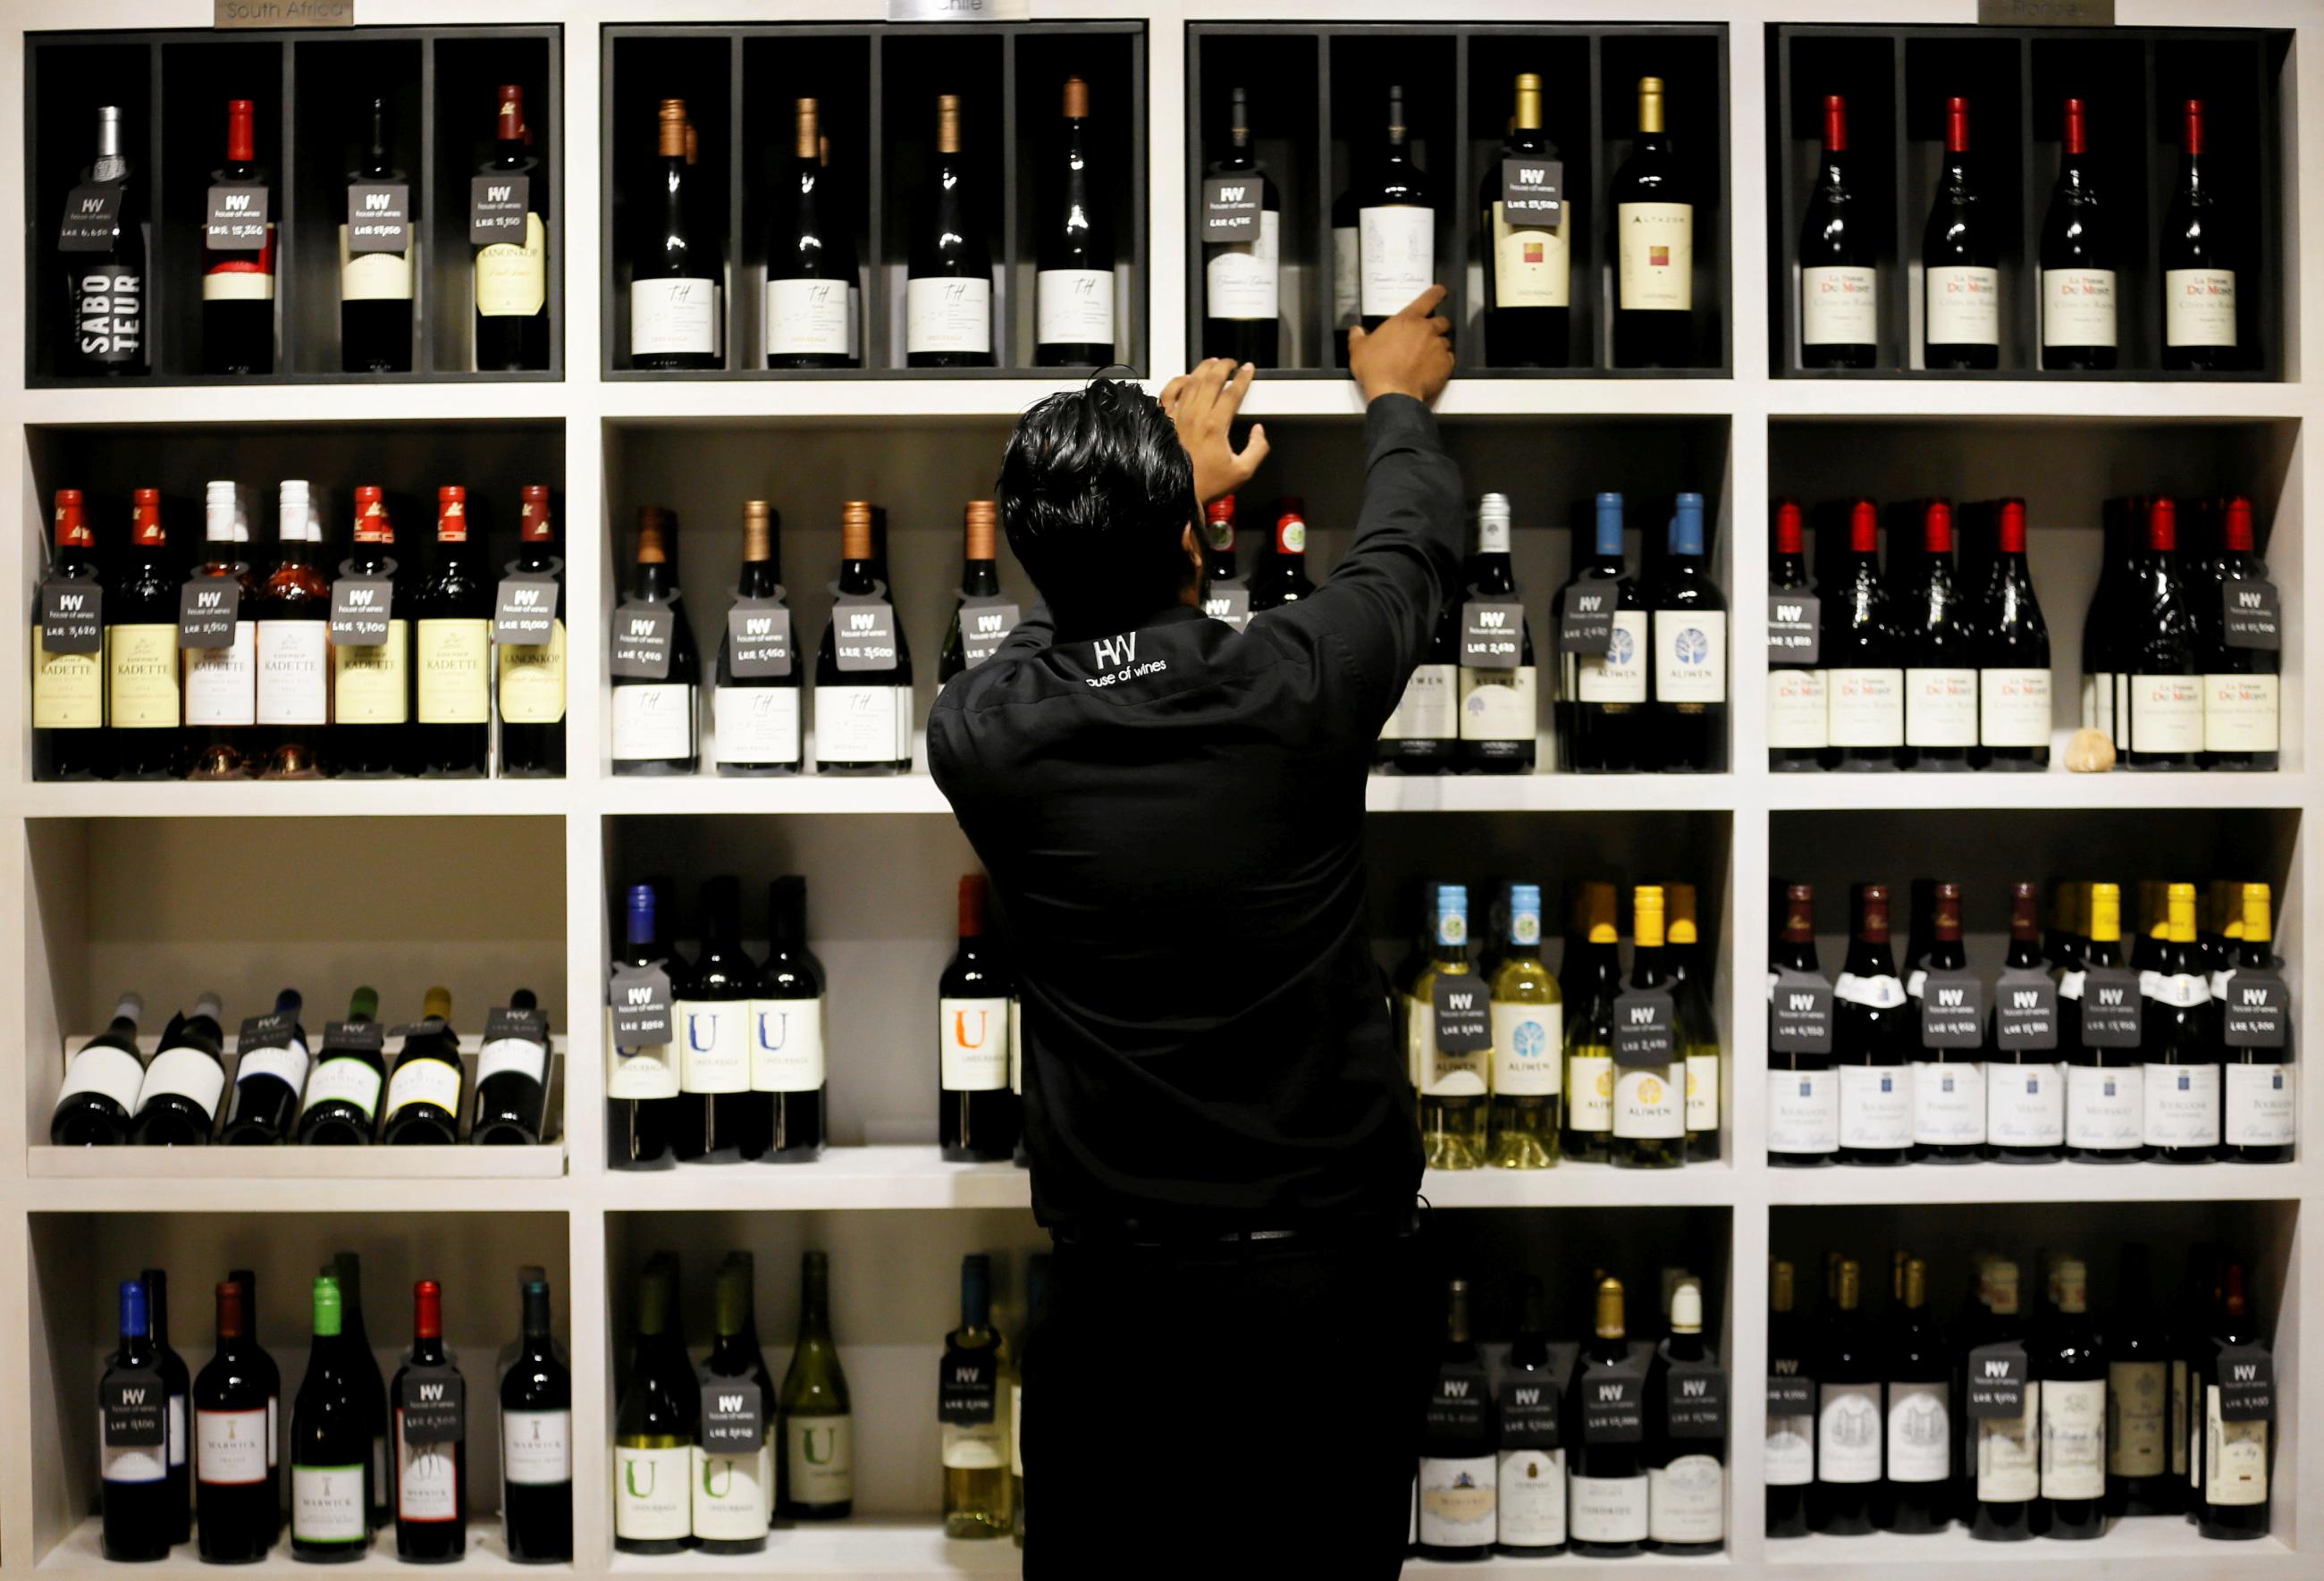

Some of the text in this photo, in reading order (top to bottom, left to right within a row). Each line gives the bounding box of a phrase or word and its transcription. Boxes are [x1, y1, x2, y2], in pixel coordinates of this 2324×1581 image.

[227, 1, 343, 19] South Africa
[81, 275, 111, 354] SABO
[113, 275, 139, 353] TEUR
[1093, 632, 1135, 669] HW
[42, 664, 91, 675] KADETTE
[118, 665, 167, 675] KADETTE
[193, 661, 244, 672] KADETTE
[265, 660, 316, 671] KADETTE
[344, 660, 394, 670] KADETTE
[427, 660, 477, 669] KADETTE
[1118, 666, 1132, 681] of
[1134, 660, 1166, 677] wines
[687, 1013, 719, 1052] U
[756, 1013, 788, 1051] U
[953, 1010, 988, 1049] U
[1436, 1062, 1478, 1072] ALIWEN
[1508, 1062, 1550, 1072] ALIWEN
[1629, 1107, 1671, 1116] ALIWEN
[804, 1428, 834, 1465] U
[626, 1459, 656, 1498] U
[703, 1459, 733, 1498] U
